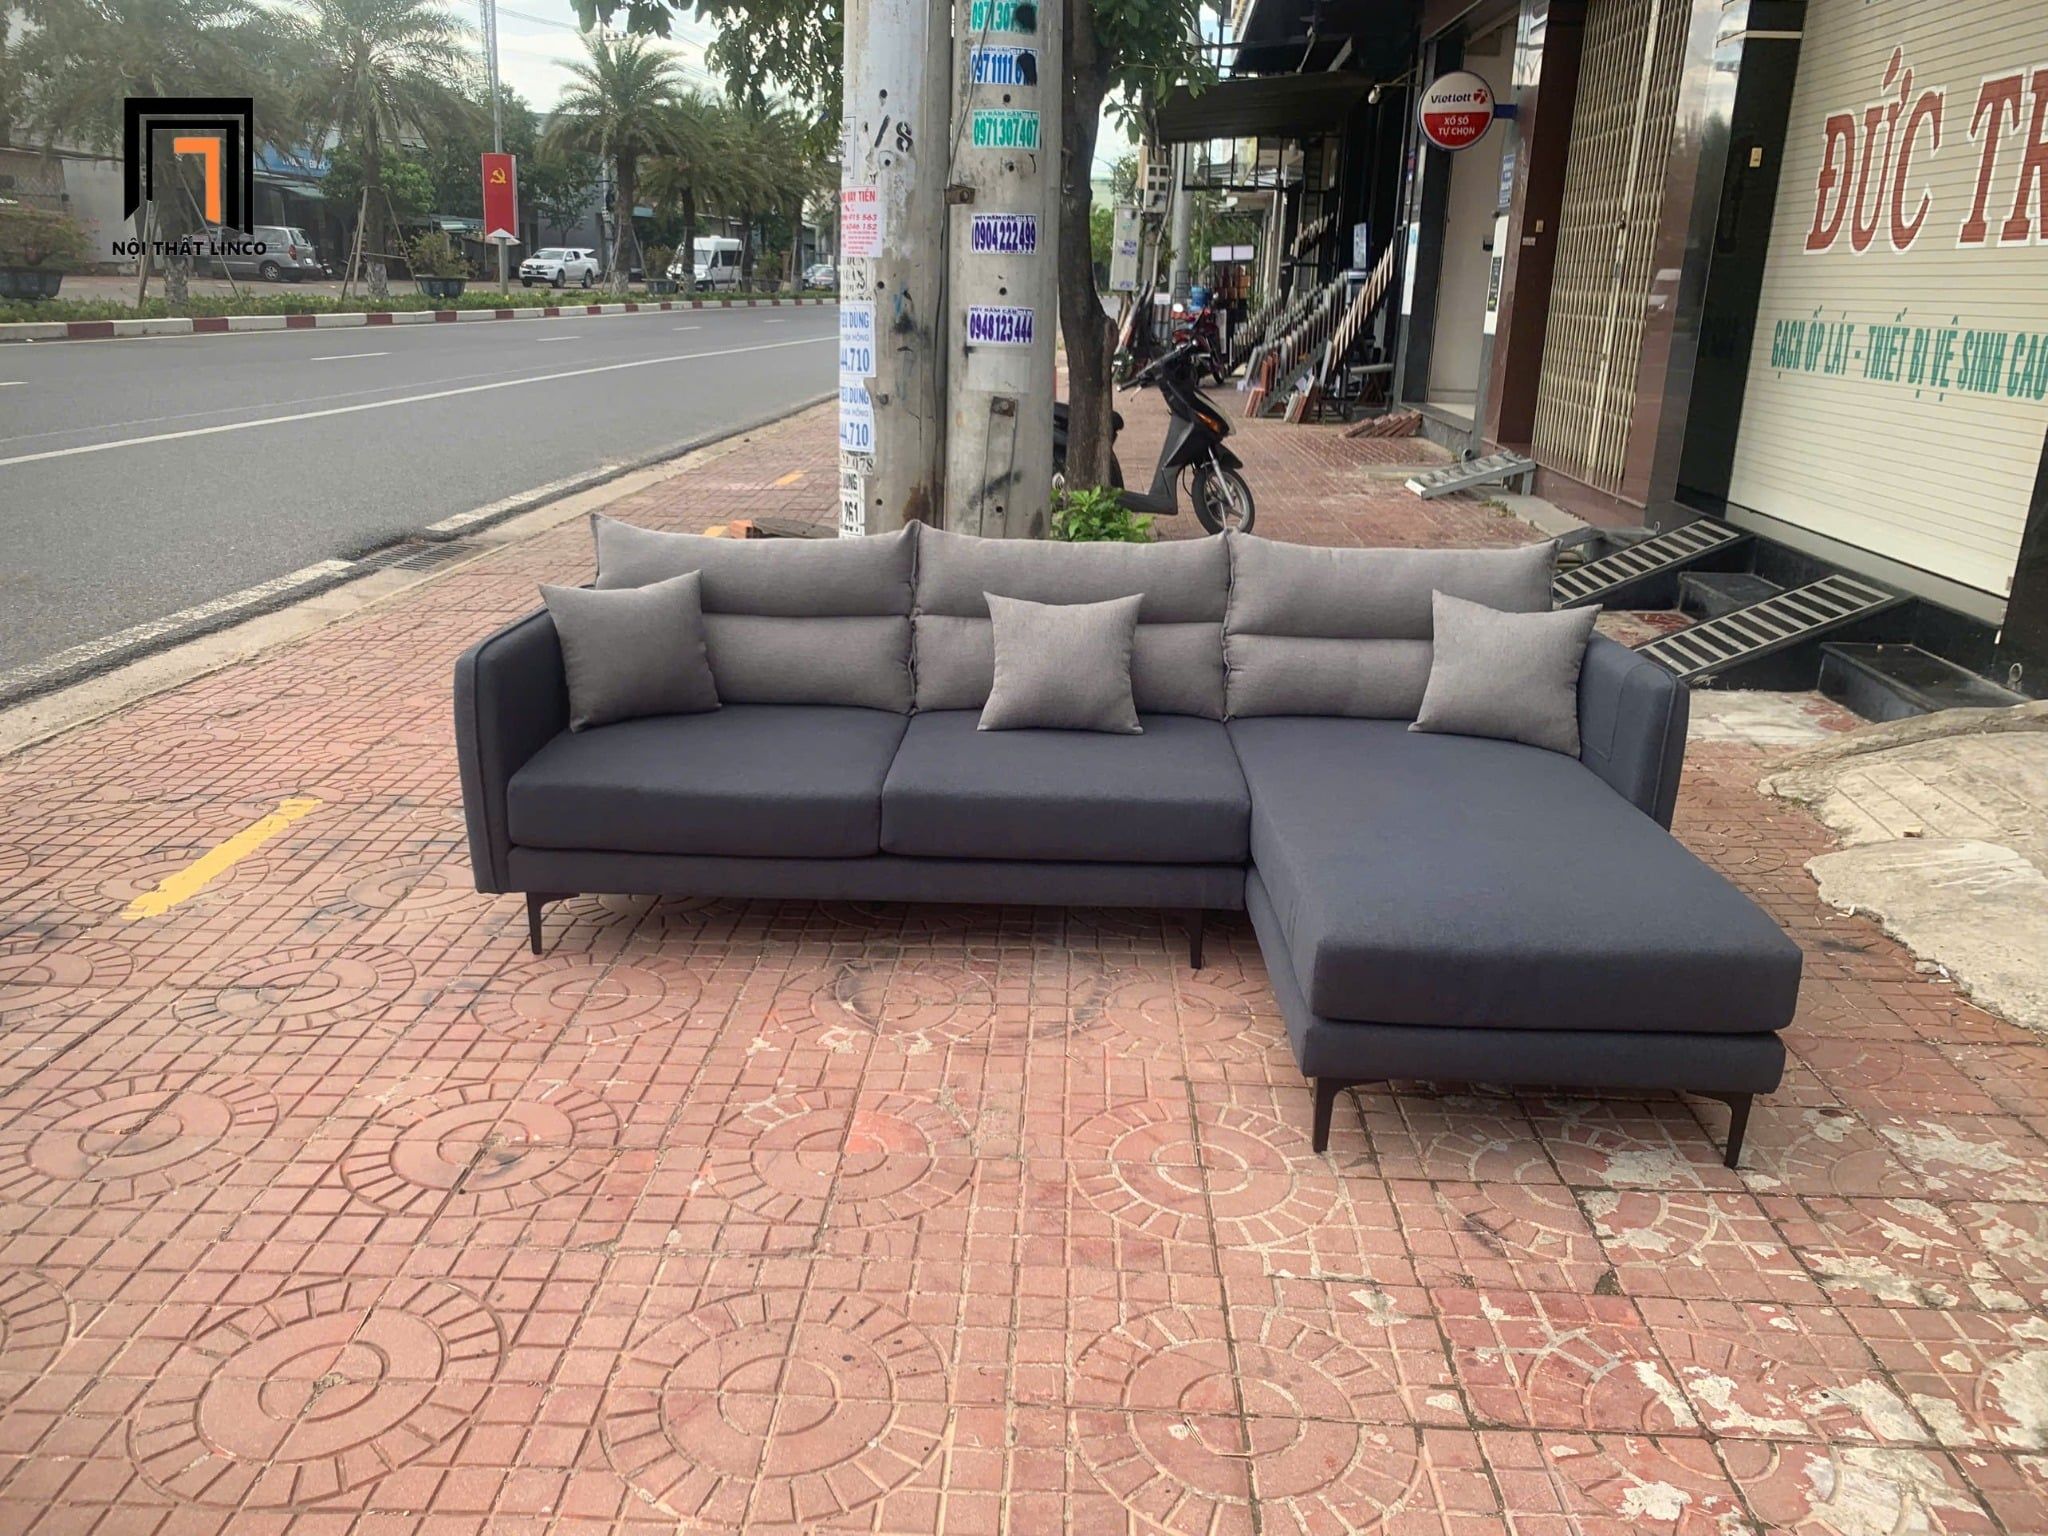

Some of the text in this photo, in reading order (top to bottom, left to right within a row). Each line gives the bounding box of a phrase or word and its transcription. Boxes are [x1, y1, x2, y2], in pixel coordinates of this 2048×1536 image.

[1431, 93, 1472, 104] Vietlott
[1444, 115, 1469, 125] XỔ SỐ
[1438, 126, 1476, 137] TỰ CHỌN
[1804, 46, 1945, 253] ĐỨC
[969, 313, 1033, 343] 0948.123.444
[1771, 319, 1806, 380] GẠCH
[1804, 304, 1826, 372] ỐP
[1824, 311, 1855, 376] LÁT
[1863, 307, 1910, 383] THIẾT
[1907, 328, 1931, 399] BỊ
[1930, 314, 1959, 402] VỆ
[1957, 329, 2008, 394] SINH
